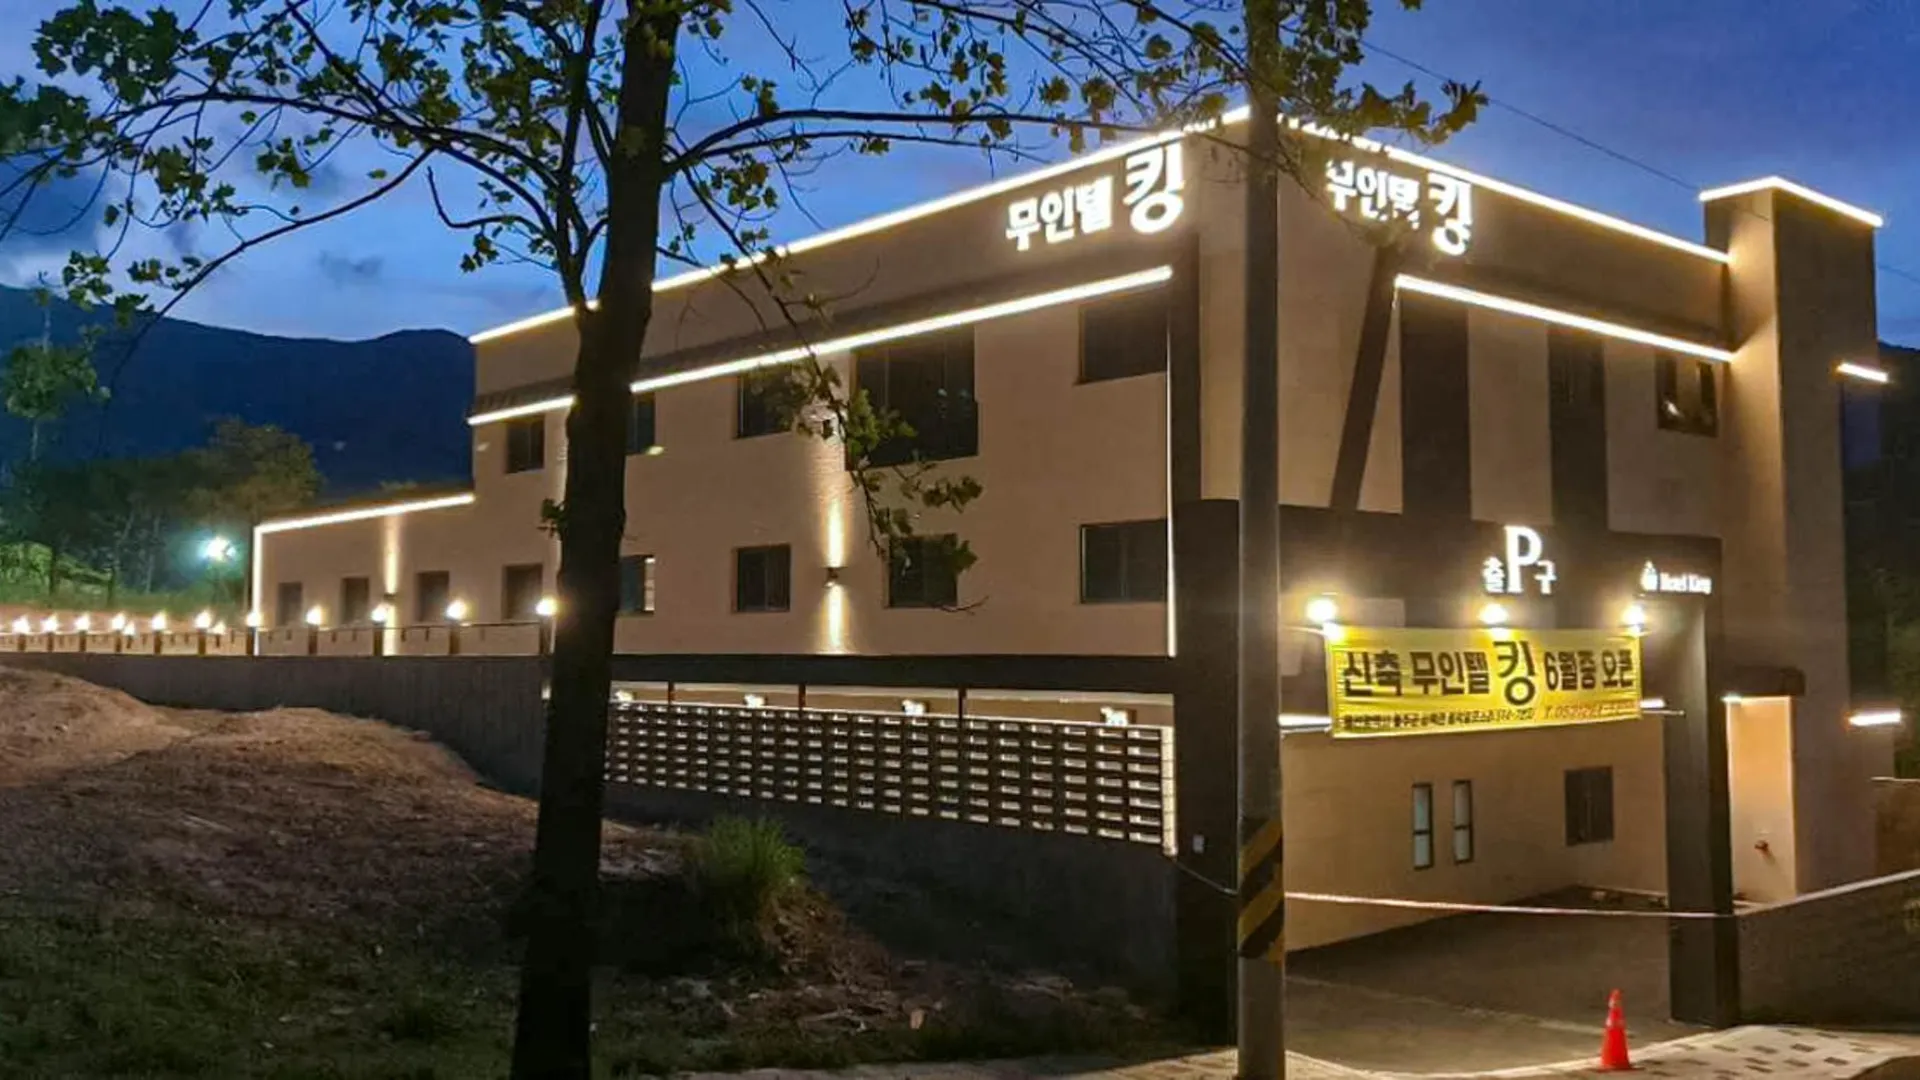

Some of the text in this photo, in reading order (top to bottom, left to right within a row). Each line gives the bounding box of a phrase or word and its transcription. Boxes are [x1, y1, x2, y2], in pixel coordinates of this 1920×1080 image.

[1005, 142, 1186, 252] 무인텔 킹
[1428, 172, 1474, 256] 킹
[1343, 640, 1635, 707] 신축 무인텔 킹 6월중 오픈
